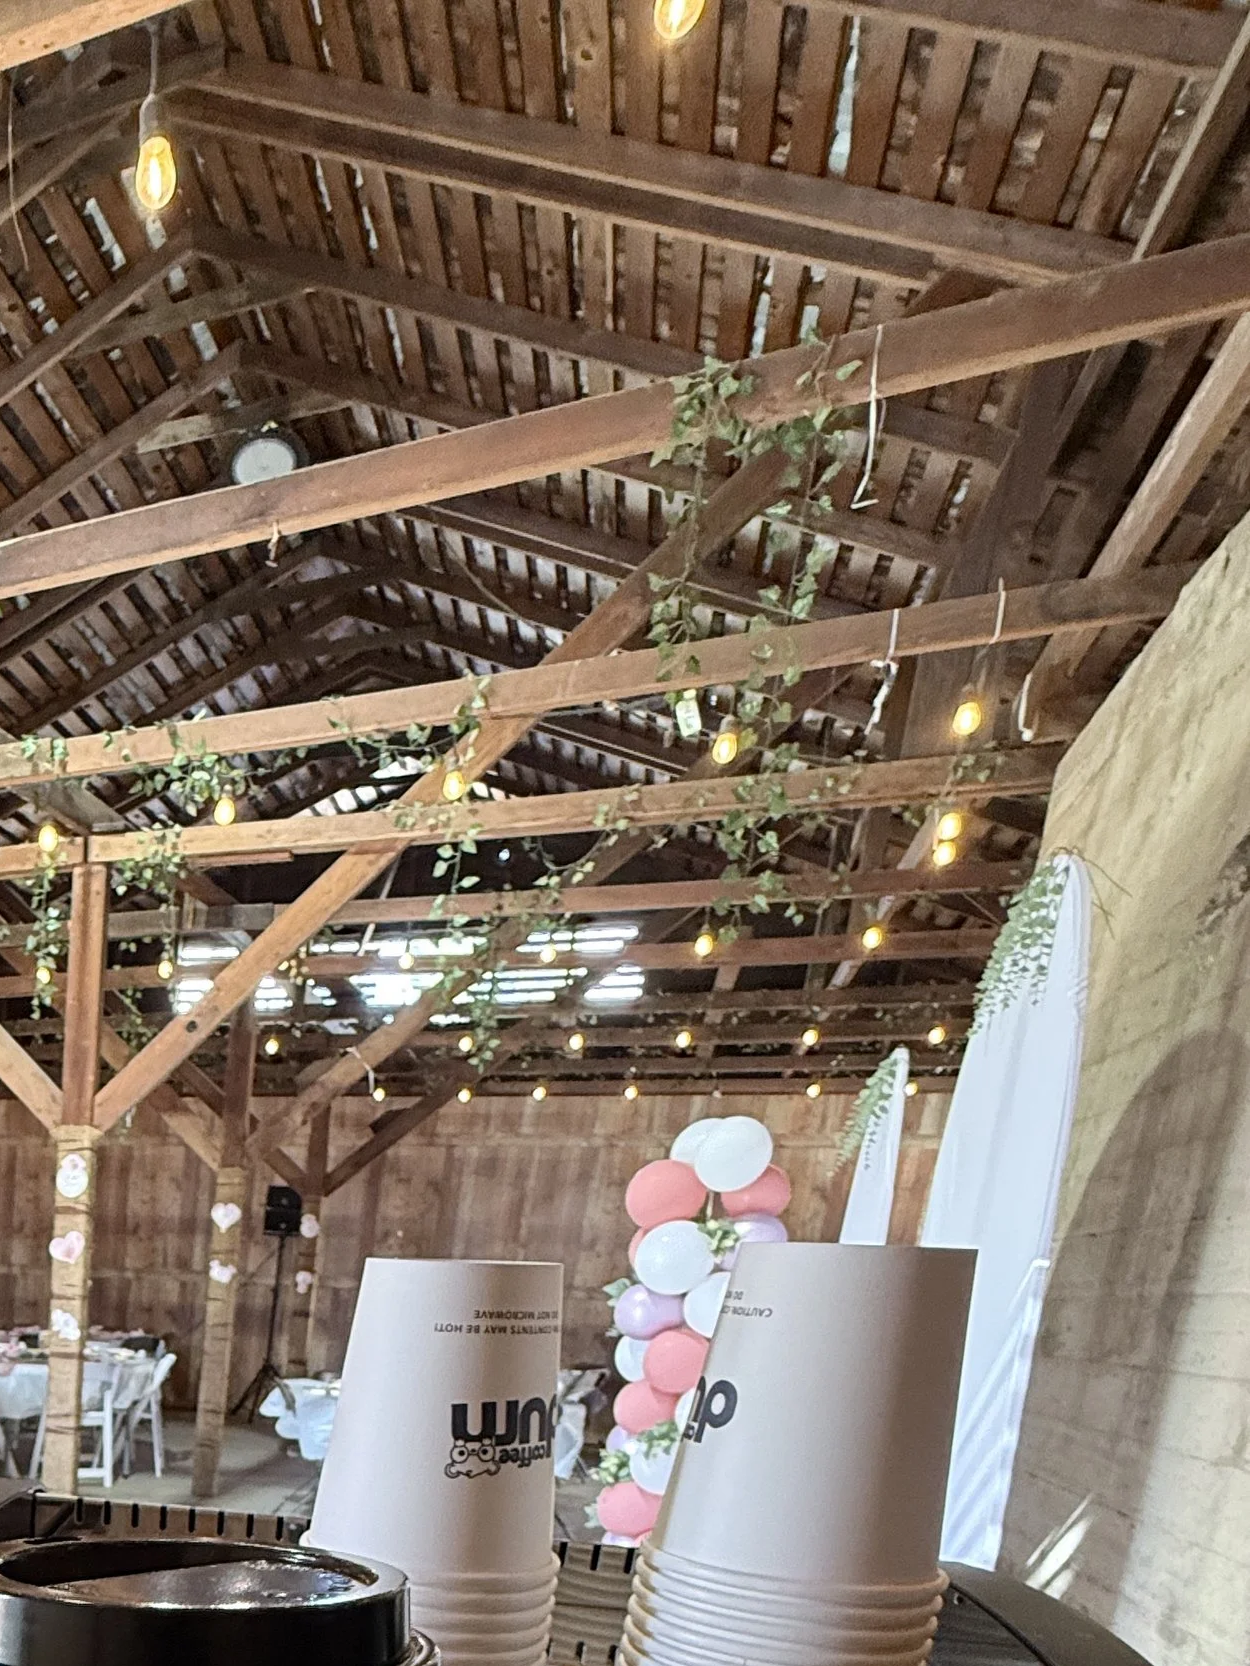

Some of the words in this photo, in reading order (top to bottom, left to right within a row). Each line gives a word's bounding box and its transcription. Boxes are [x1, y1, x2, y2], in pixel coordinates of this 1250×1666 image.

[474, 1310, 535, 1320] MICROWAVE
[434, 1323, 463, 1334] HOT!
[466, 1324, 480, 1334] BE
[483, 1324, 508, 1334] MAY
